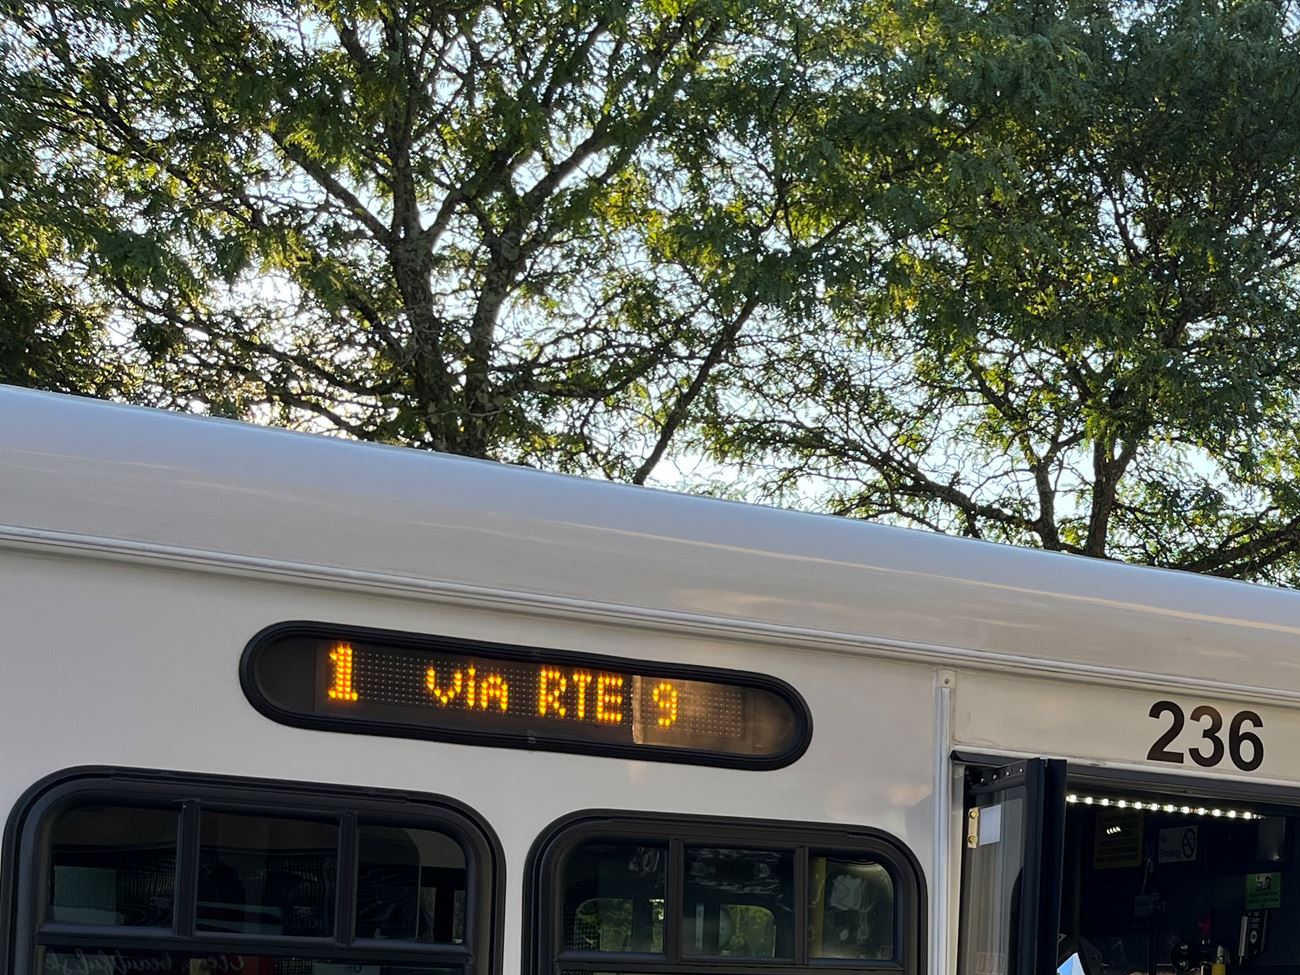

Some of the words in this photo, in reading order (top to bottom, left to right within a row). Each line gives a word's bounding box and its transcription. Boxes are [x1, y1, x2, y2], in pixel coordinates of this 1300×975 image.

[328, 641, 359, 702] 1
[539, 665, 623, 724] RTE
[652, 681, 680, 729] 9
[1147, 700, 1265, 772] 236
